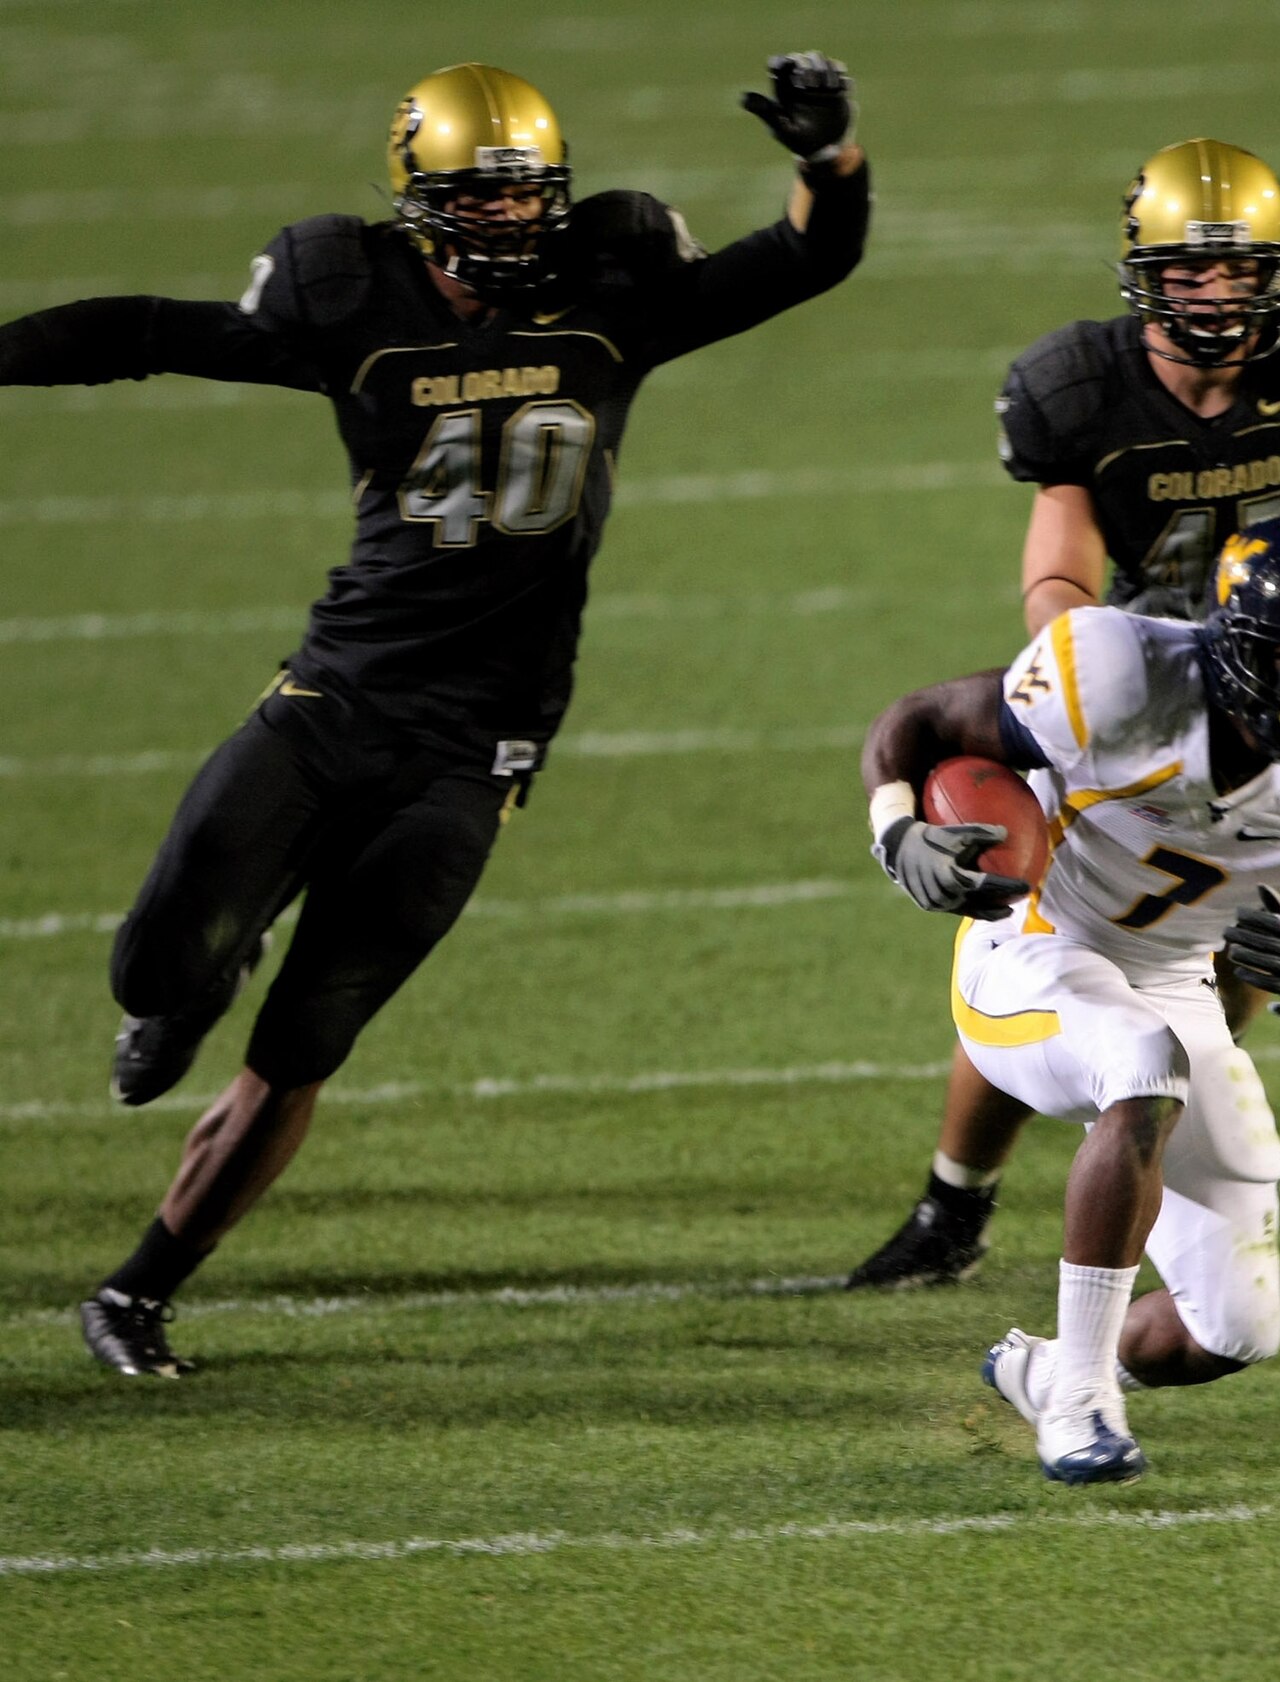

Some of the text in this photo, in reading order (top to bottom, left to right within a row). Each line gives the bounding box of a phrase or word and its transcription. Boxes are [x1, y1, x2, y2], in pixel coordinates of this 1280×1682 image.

[411, 365, 560, 407] COLORADO
[397, 397, 596, 548] 40
[1111, 841, 1231, 933] 7
